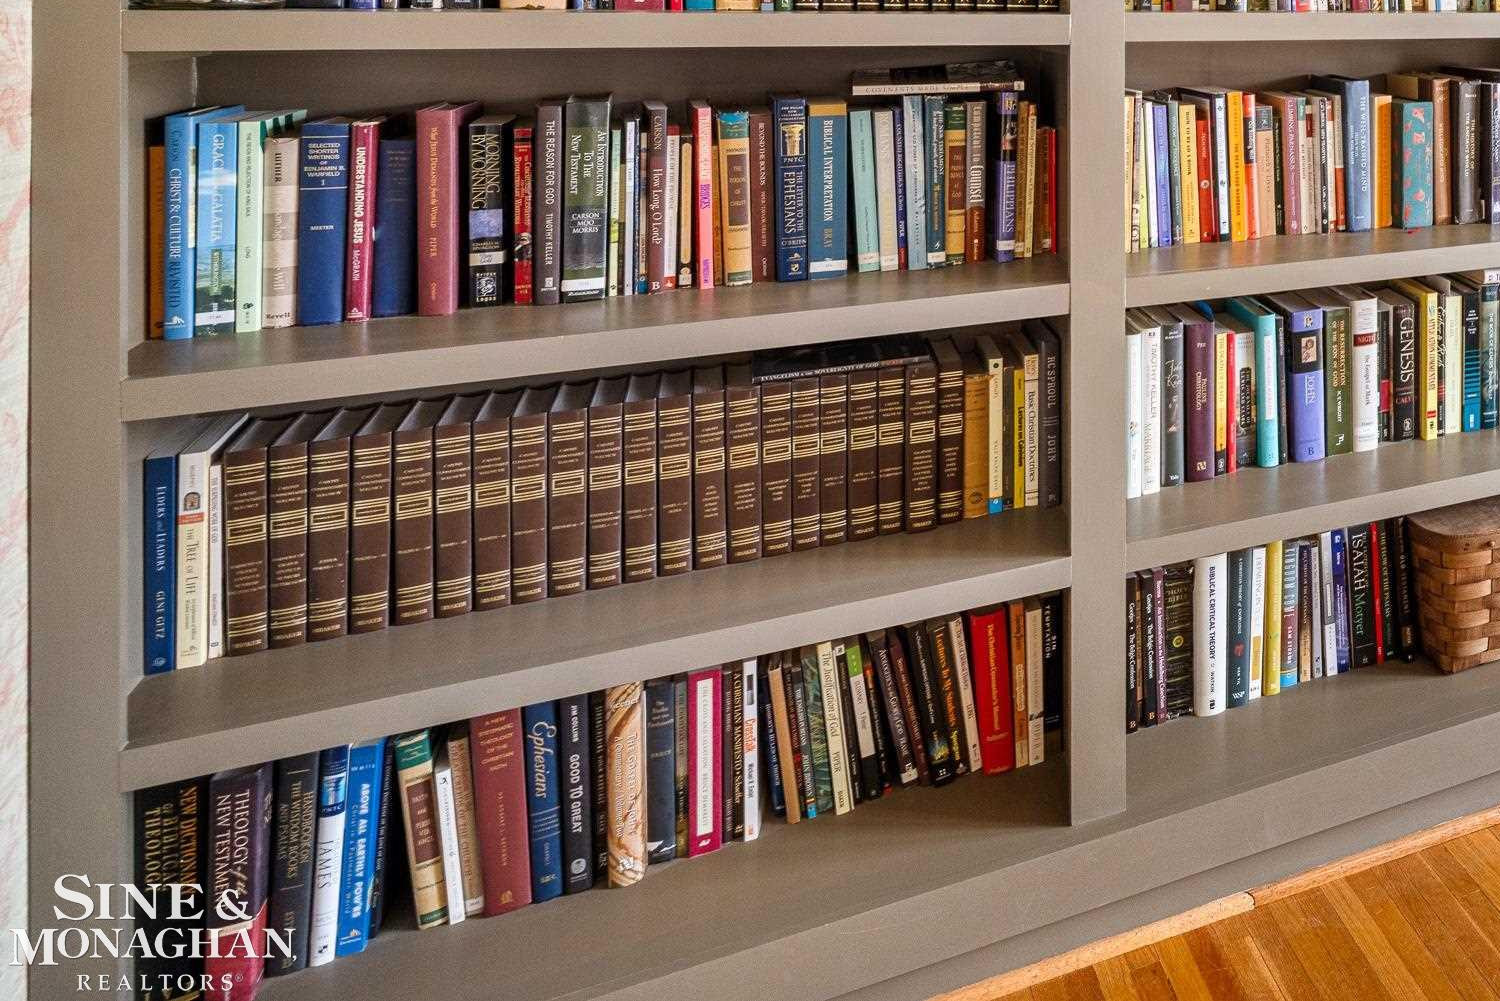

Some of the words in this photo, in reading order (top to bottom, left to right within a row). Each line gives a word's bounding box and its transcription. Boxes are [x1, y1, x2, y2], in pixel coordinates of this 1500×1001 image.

[472, 134, 487, 148] BY
[546, 120, 556, 140] THE
[571, 134, 582, 152] NEW
[653, 115, 662, 150] CARSON
[823, 119, 834, 155] BIBLICAL
[274, 152, 284, 183] LUTHER
[485, 133, 500, 193] MORNING
[545, 141, 556, 169] REASON
[583, 163, 594, 178] THE
[584, 150, 594, 162] TO
[596, 144, 607, 197] INTRODUCTION
[170, 169, 181, 202] CHRIST
[354, 146, 367, 217] UNDERSTANDING
[471, 149, 487, 209] MORNING
[545, 170, 555, 186] FOR
[570, 153, 581, 195] TESTAMENT
[652, 168, 663, 188] How
[822, 157, 834, 222] INTERPRETATION
[969, 164, 985, 203] Counsel
[171, 204, 181, 214] &
[545, 187, 556, 205] GOD
[783, 171, 796, 235] EPHESIANS
[1006, 163, 1016, 233] PHILIPPIANS
[353, 220, 366, 244] JESUS
[545, 213, 554, 239] TIMOTHY
[571, 212, 600, 220] CARSON
[572, 226, 600, 234] MORRIS
[170, 216, 181, 259] CULTURE
[650, 223, 662, 245] Lord?
[781, 239, 807, 247] O'BRIEN
[352, 249, 362, 282] McGRATH
[545, 241, 554, 265] KELLER
[1339, 333, 1347, 386] RESURRECTION
[1399, 316, 1415, 382] GENESIS
[1047, 370, 1057, 409] SPROUL
[1306, 375, 1316, 407] JOHN
[1047, 434, 1057, 462] JOHN
[155, 532, 168, 572] LEADERS
[1352, 534, 1366, 591] ISAIAH
[1209, 566, 1217, 598] BIBLICAL
[155, 590, 166, 614] GENE
[1209, 599, 1217, 630] CRITICAL
[1354, 593, 1366, 636] Motyer
[1044, 605, 1052, 659] TEMPTATION
[1209, 631, 1217, 660] THEORY
[571, 705, 579, 716] JIM
[733, 681, 744, 723] CHRISTIAN
[570, 717, 580, 743] COLLINS
[528, 720, 558, 799] Ephesians
[733, 726, 743, 770] MANIFESTO
[569, 753, 581, 784] GOOD
[359, 783, 370, 815] ABOVE
[569, 785, 584, 799] TO
[215, 793, 231, 827] NEW
[358, 818, 368, 834] ALL
[570, 800, 583, 833] GREAT
[233, 789, 250, 865] THEOLOGY
[319, 840, 335, 890] JAMES
